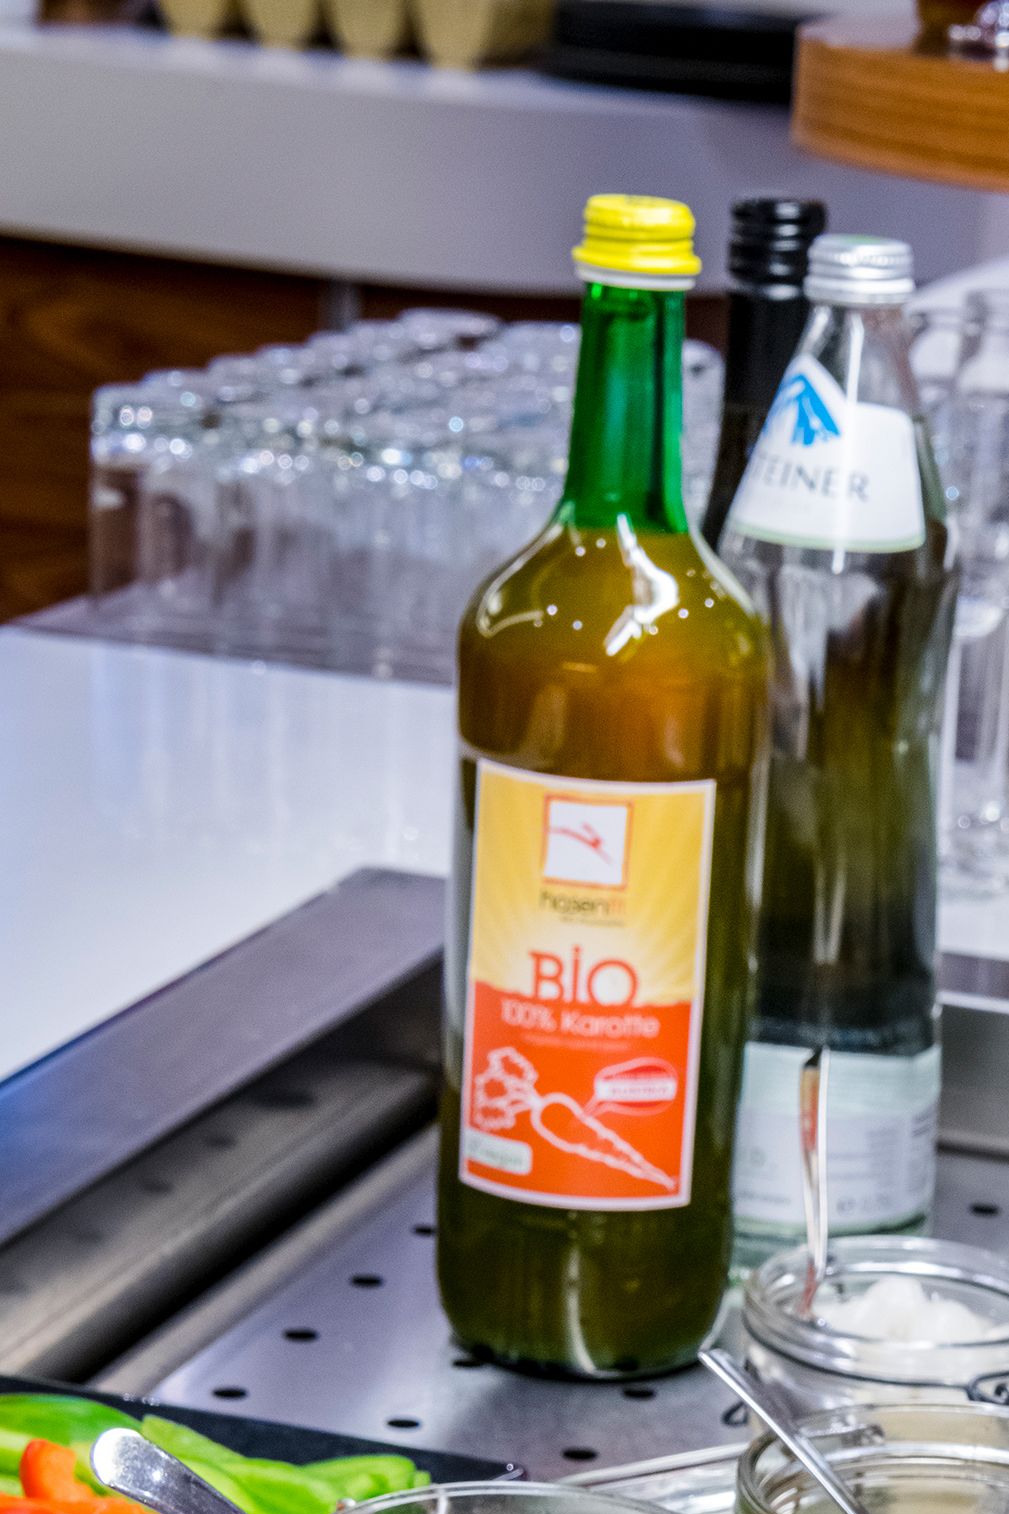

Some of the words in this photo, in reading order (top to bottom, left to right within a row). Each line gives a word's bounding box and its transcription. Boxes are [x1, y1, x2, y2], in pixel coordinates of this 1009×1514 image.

[748, 452, 870, 503] TEINER
[501, 999, 557, 1032] 100%
[560, 1009, 661, 1039] Karotte
